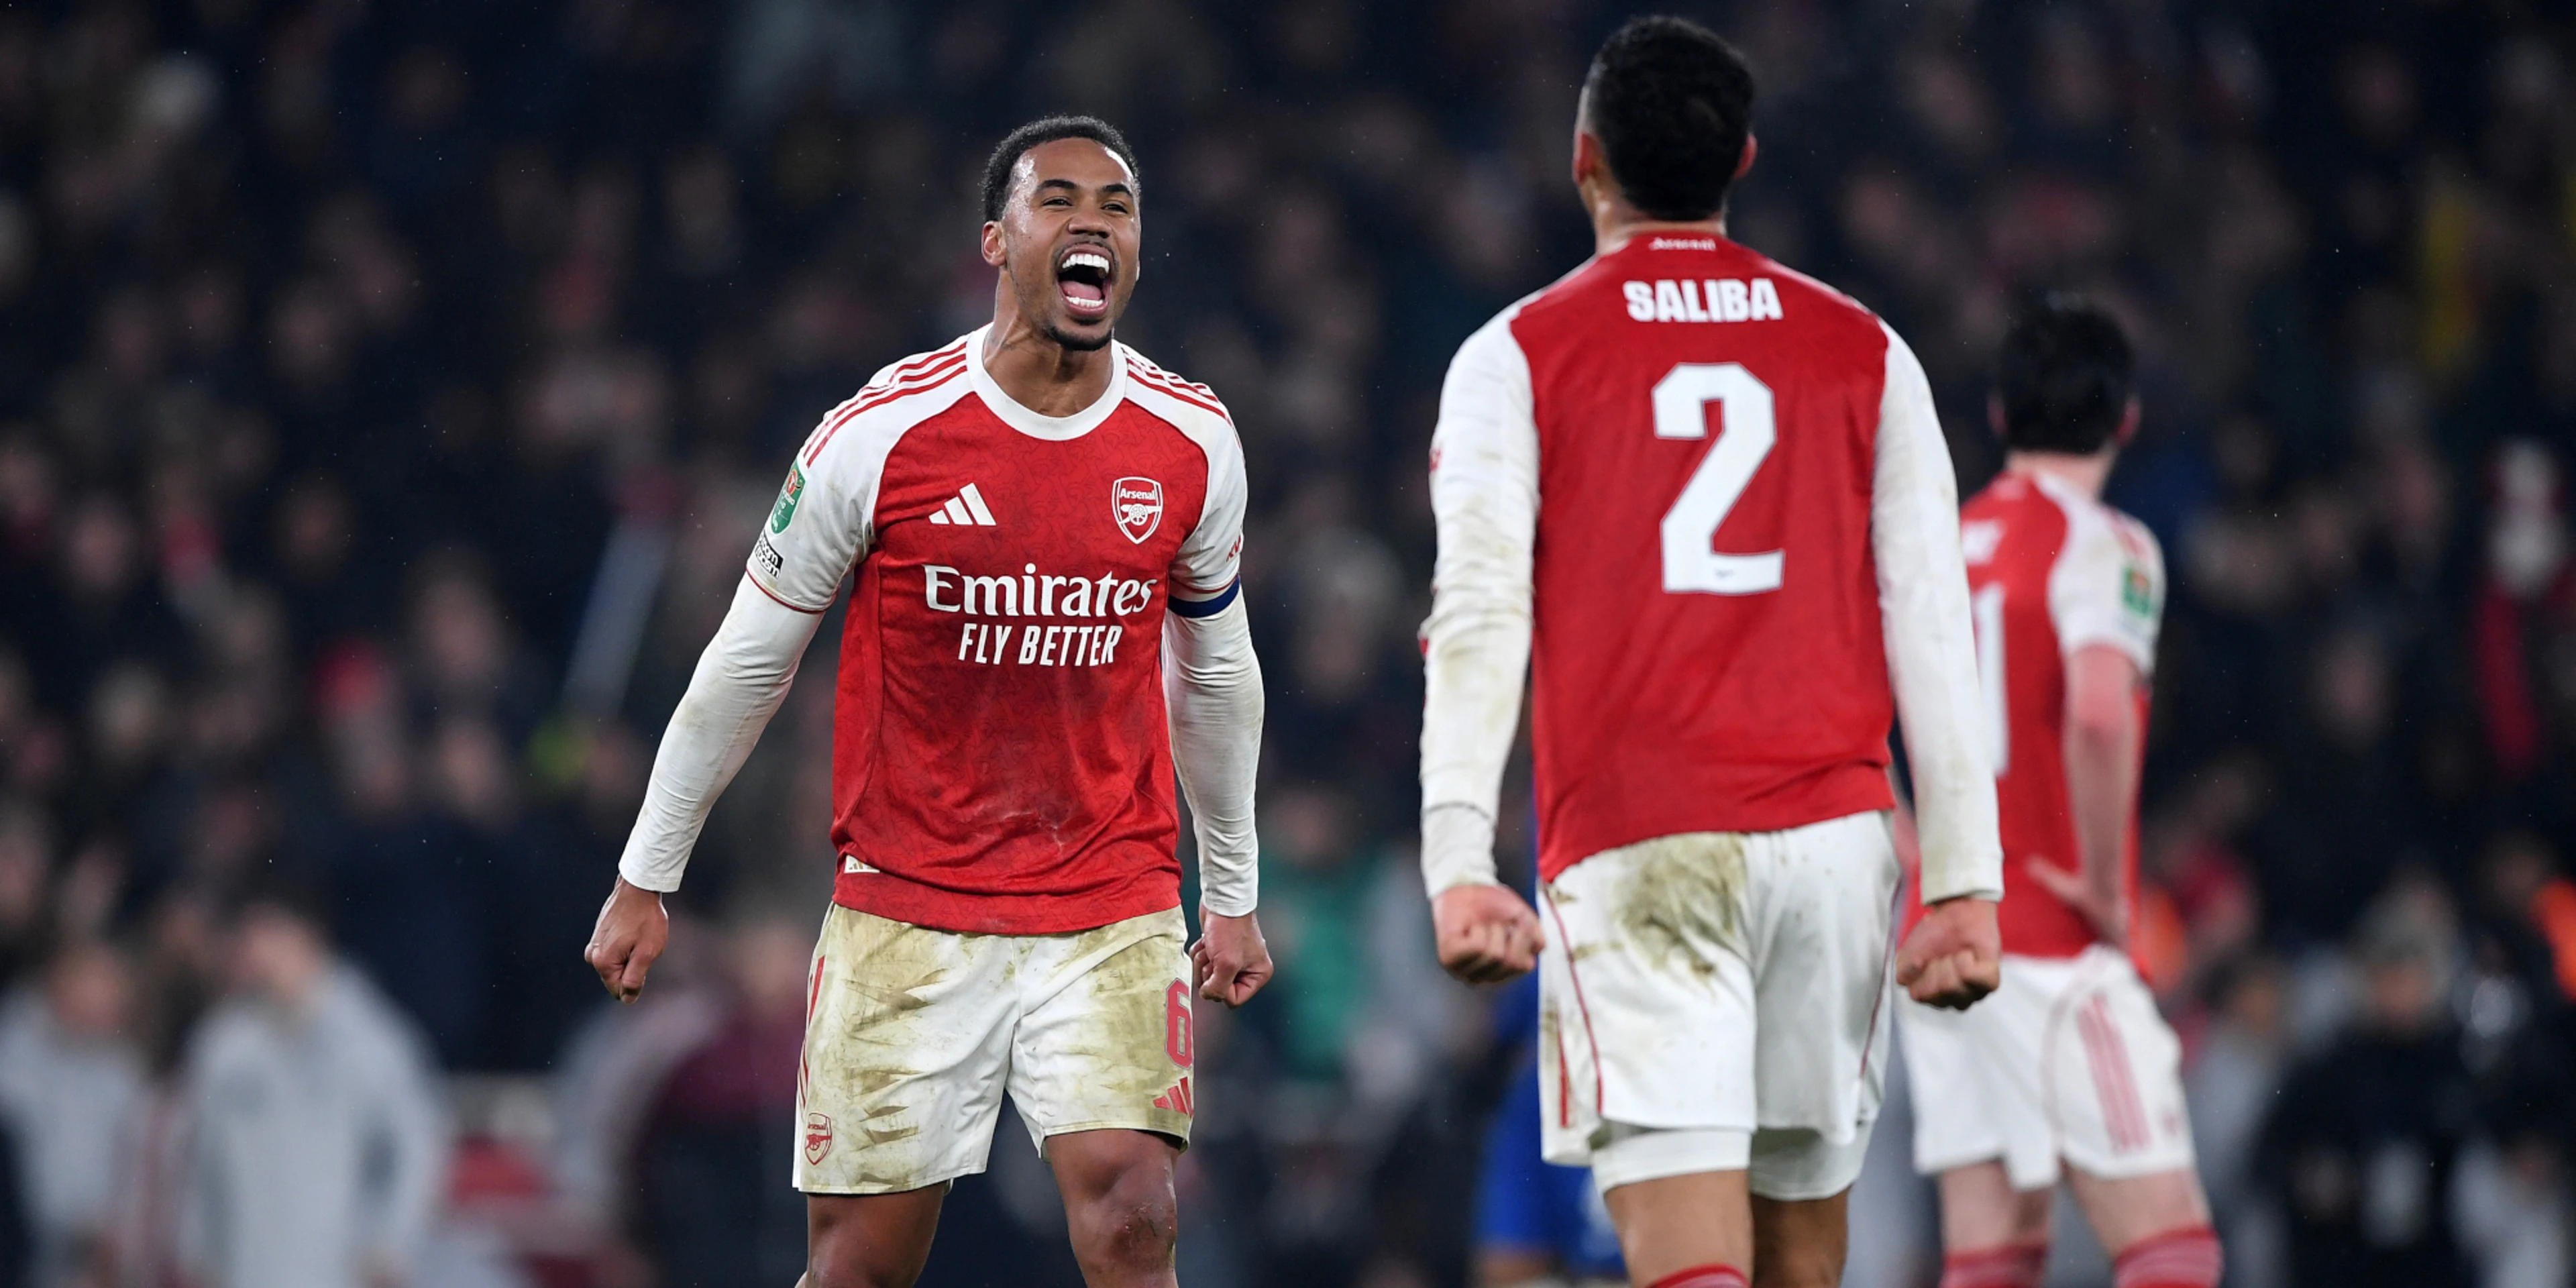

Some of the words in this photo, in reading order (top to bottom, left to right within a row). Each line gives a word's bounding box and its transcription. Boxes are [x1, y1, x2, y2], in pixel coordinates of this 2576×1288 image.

[1622, 277, 1784, 323] SALIBA
[1120, 487, 1156, 500] Arsenal
[1651, 362, 1785, 596] 2
[922, 562, 1157, 617] Emirates
[958, 623, 1012, 665] FLY
[1018, 625, 1123, 667] BETTER
[1165, 977, 1193, 1071] 6
